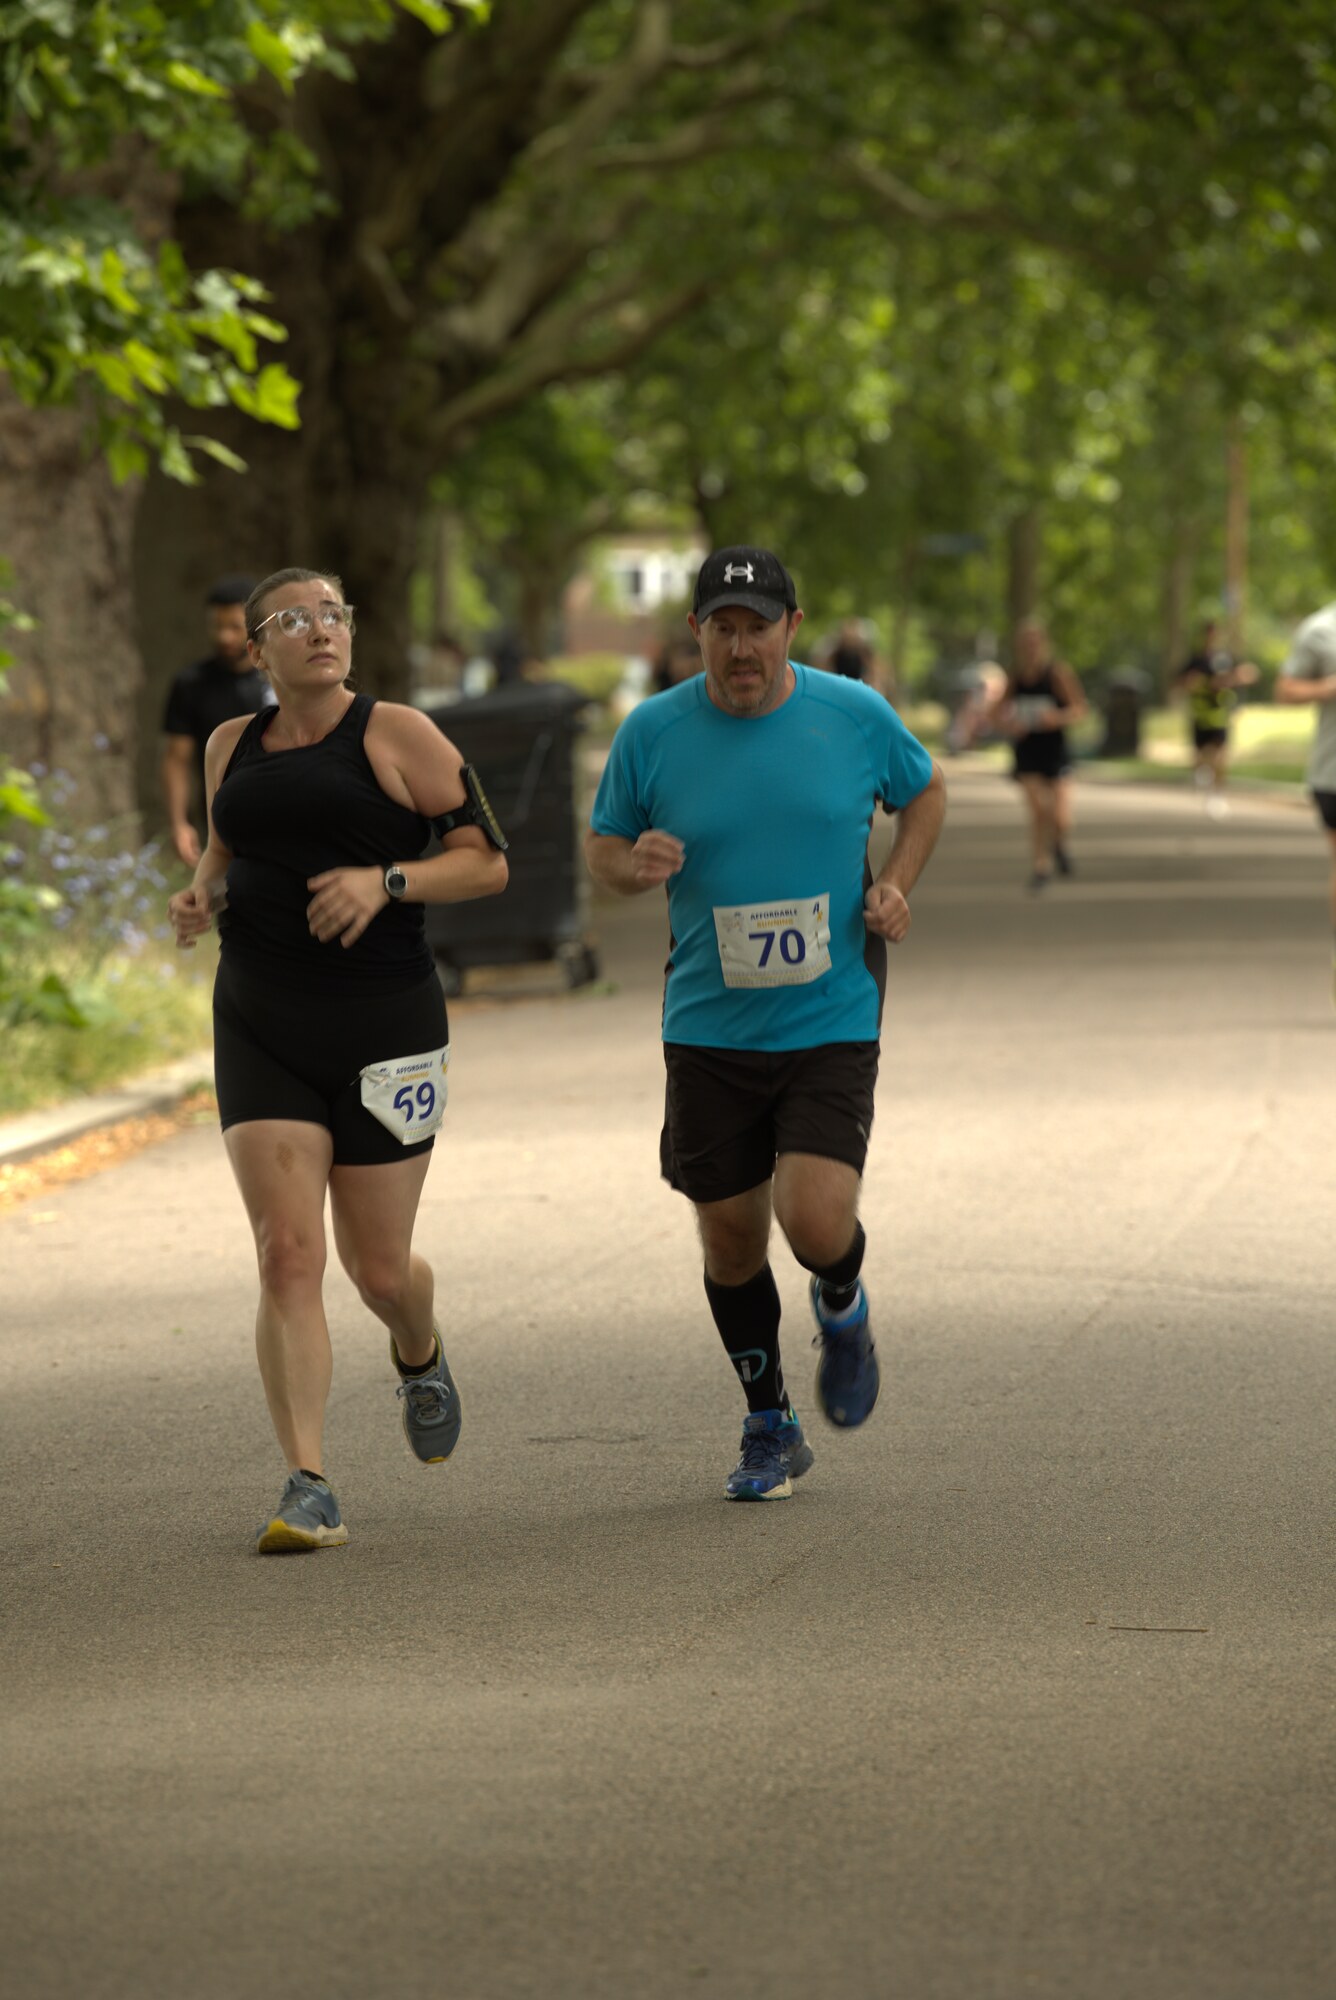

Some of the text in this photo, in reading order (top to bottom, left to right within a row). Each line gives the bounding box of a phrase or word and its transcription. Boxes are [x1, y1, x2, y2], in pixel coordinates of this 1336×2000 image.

[750, 908, 797, 921] AFFORDABLE
[748, 929, 806, 969] 70
[396, 1060, 433, 1075] AFFORDABLE
